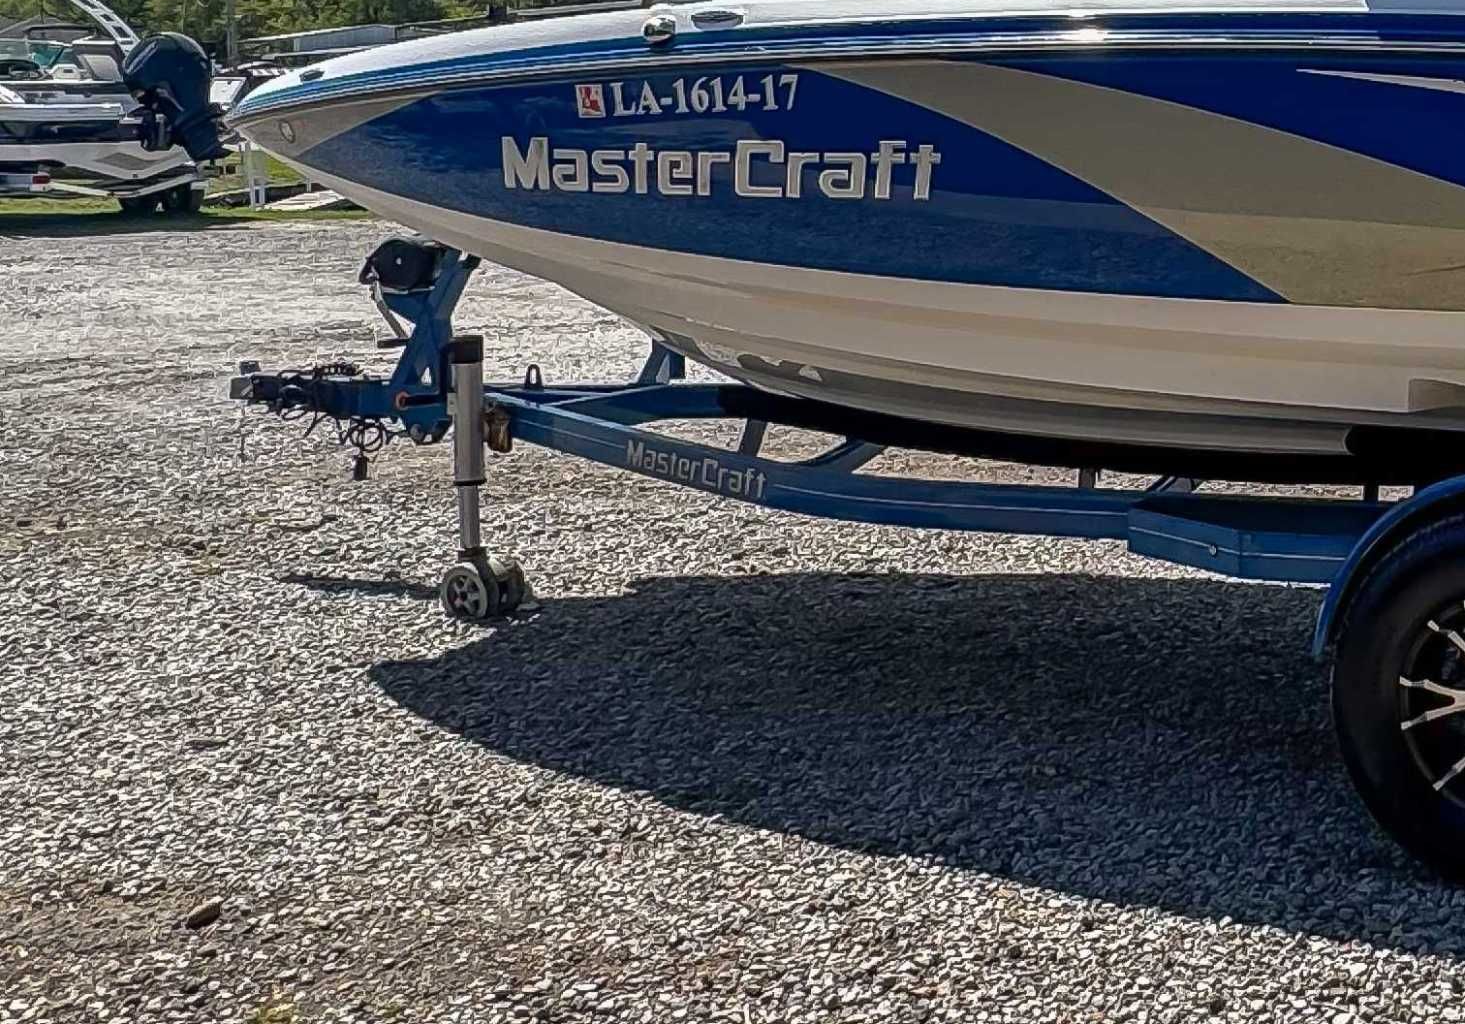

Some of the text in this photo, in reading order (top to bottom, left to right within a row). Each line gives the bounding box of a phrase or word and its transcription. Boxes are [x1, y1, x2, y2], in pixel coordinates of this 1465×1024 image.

[609, 75, 798, 116] LA-1614-17
[501, 136, 941, 199] MasterCraft
[626, 439, 766, 498] MasterCraft
